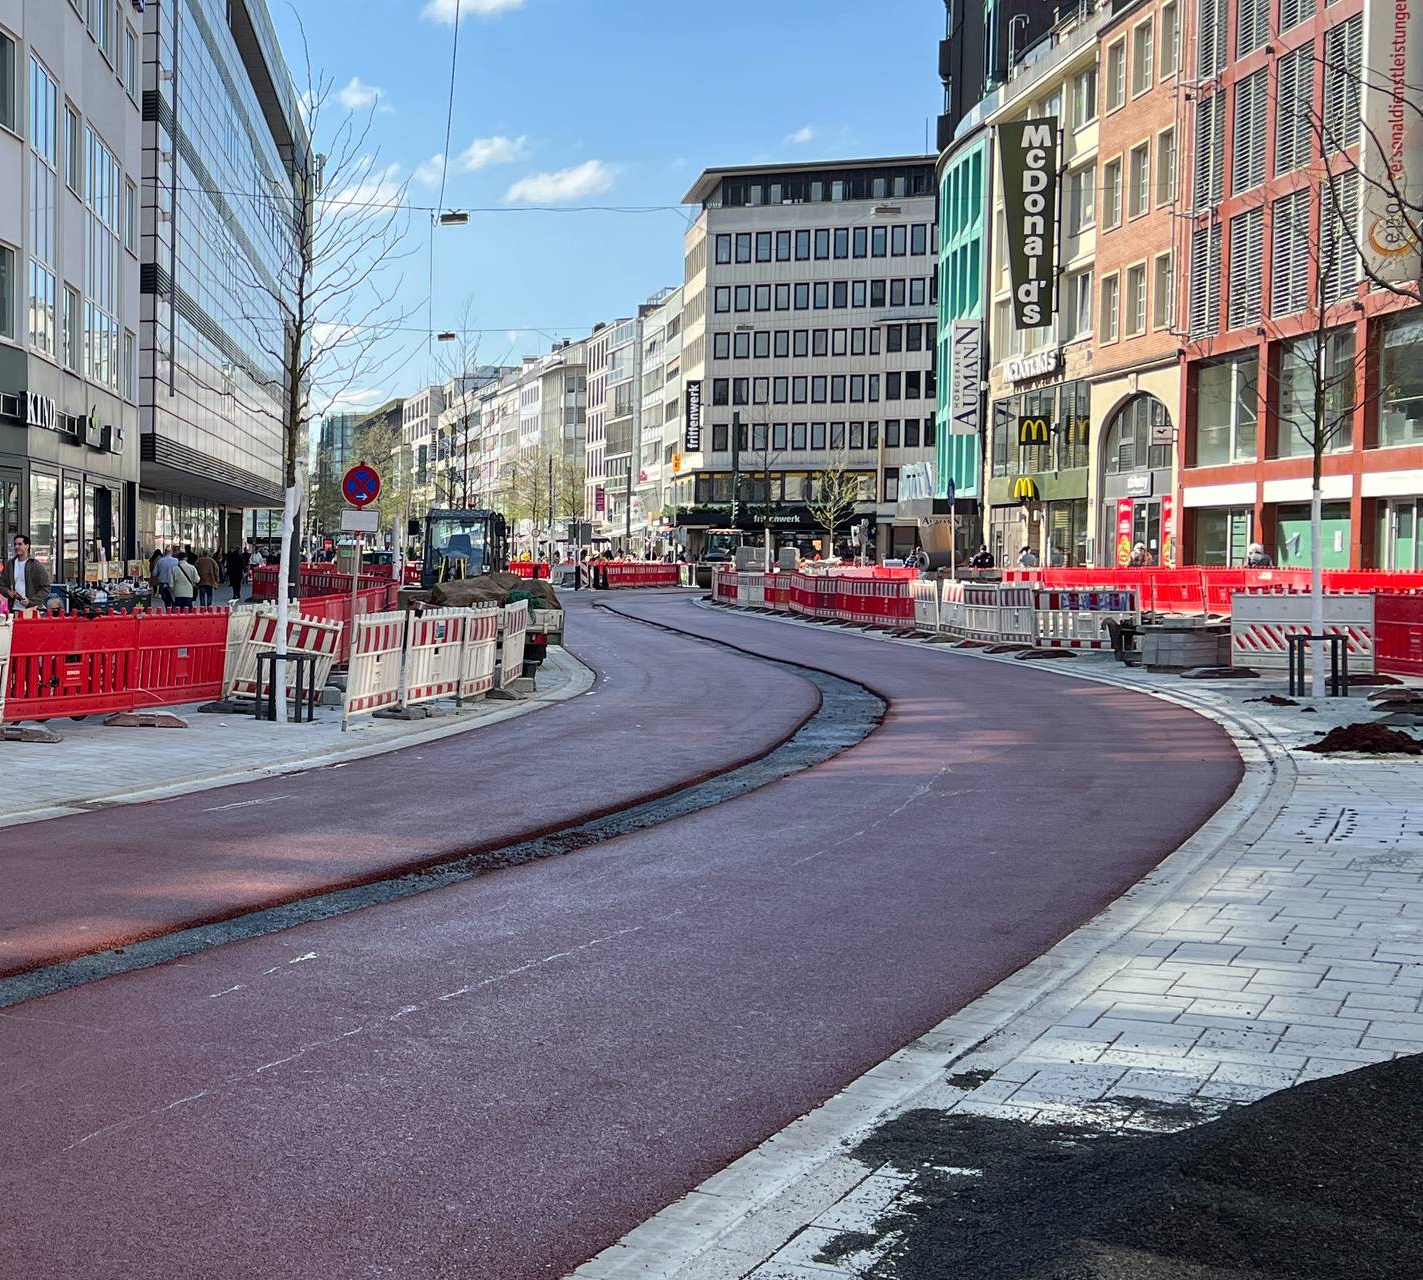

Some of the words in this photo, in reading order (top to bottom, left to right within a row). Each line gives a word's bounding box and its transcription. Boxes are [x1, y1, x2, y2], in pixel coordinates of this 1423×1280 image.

[1018, 125, 1052, 325] McDonald's
[26, 391, 56, 430] KIND
[687, 383, 700, 449] frittenwerk
